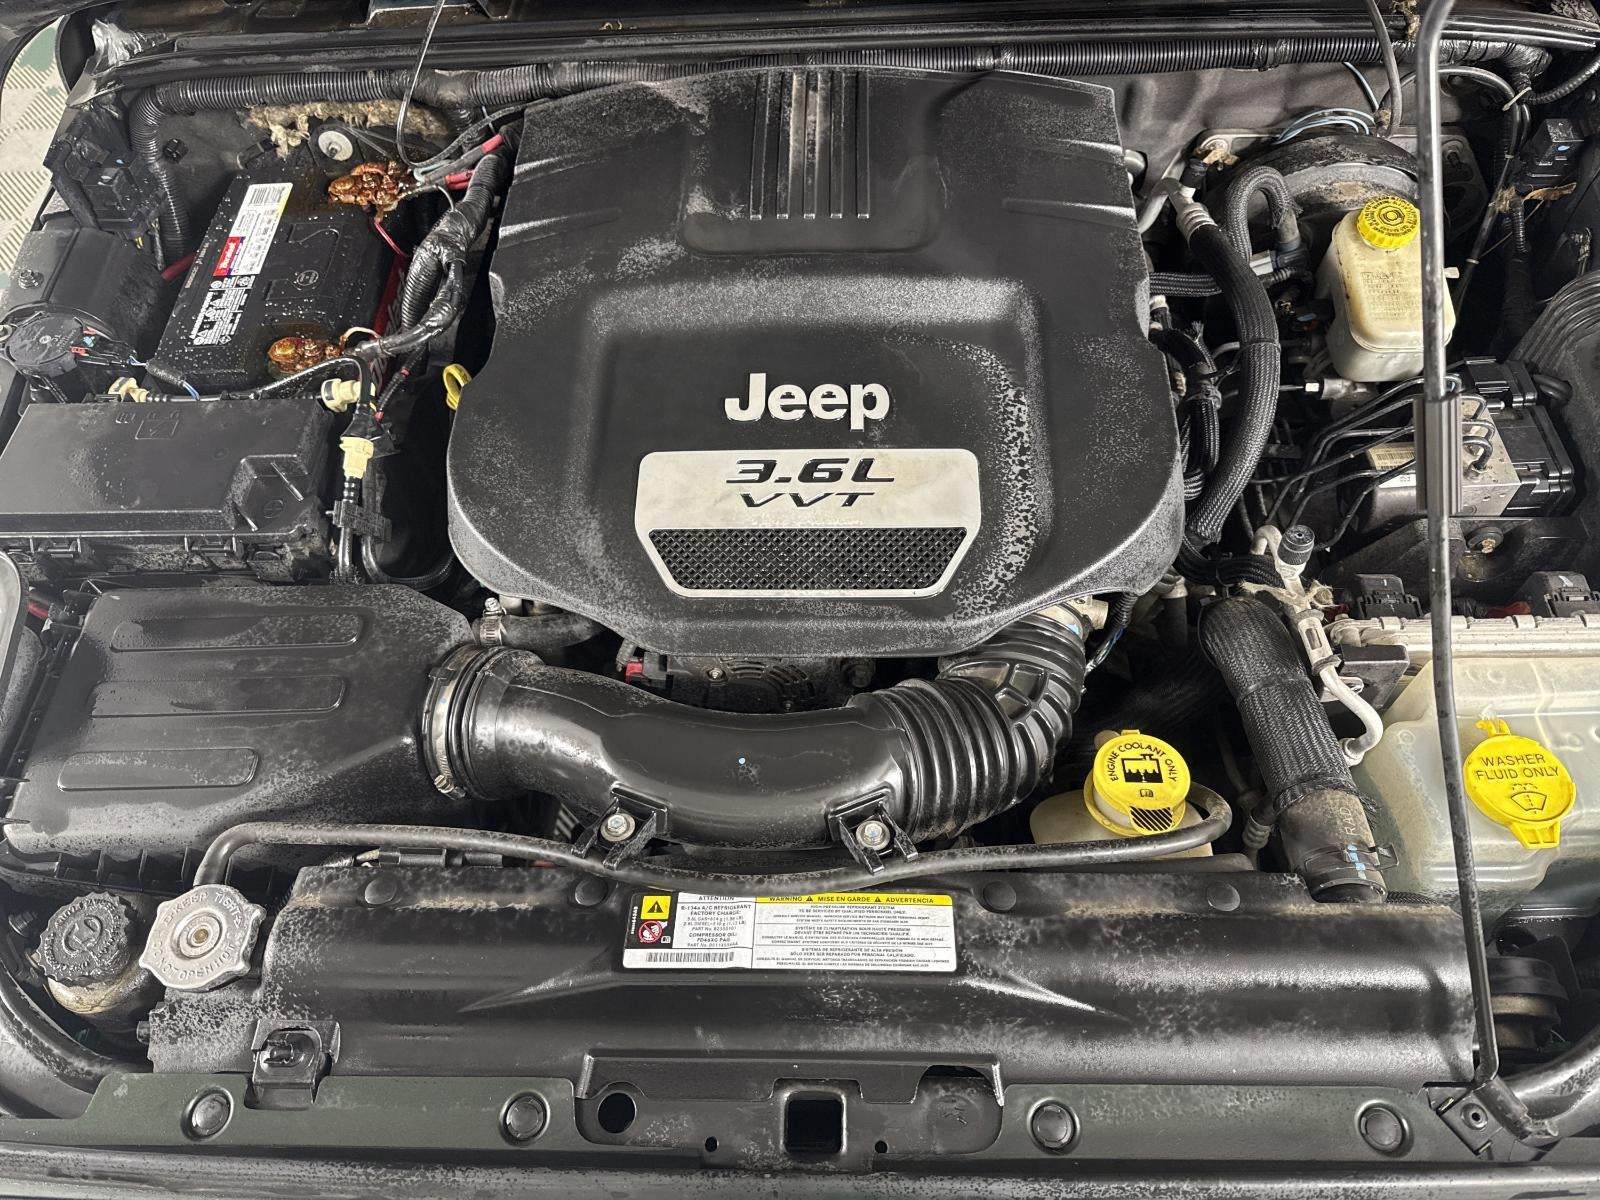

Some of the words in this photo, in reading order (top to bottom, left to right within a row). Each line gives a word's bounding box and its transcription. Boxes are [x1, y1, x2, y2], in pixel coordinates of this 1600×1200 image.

[725, 373, 890, 432] Jeep
[726, 458, 895, 483] 3.6L
[740, 492, 875, 508] VVT
[1107, 751, 1119, 782] ENGINE
[1118, 742, 1166, 757] COOLANT
[1164, 758, 1178, 782] ONLY
[1481, 753, 1546, 767] WASHER
[1475, 768, 1518, 780] FLUID
[1522, 766, 1559, 778] ONLY
[1340, 807, 1360, 835] RAD
[173, 891, 208, 914] KEEP
[214, 890, 242, 916] TIGHT
[179, 962, 213, 981] OPEN
